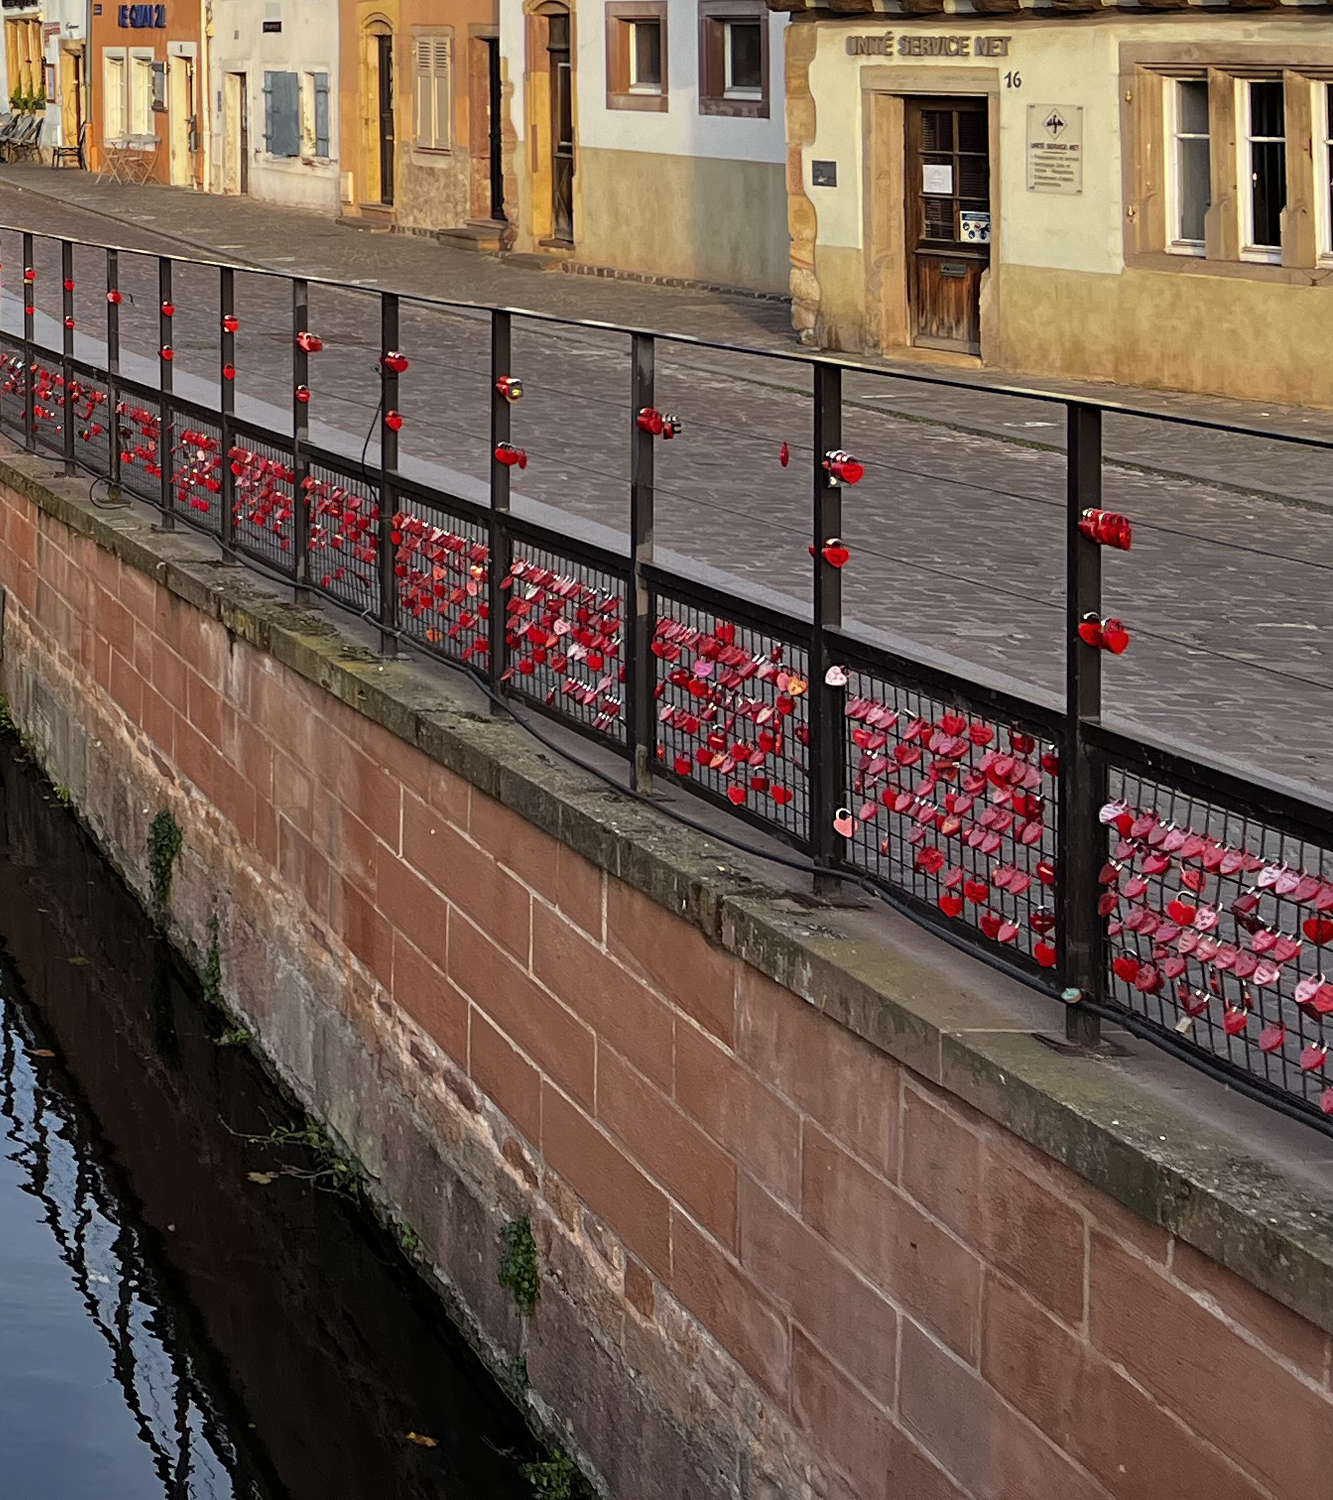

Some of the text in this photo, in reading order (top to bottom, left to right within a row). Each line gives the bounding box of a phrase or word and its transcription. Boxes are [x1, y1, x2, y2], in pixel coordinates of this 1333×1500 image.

[845, 31, 1012, 57] UNITÉ SERVICE NET
[1004, 71, 1023, 88] 16
